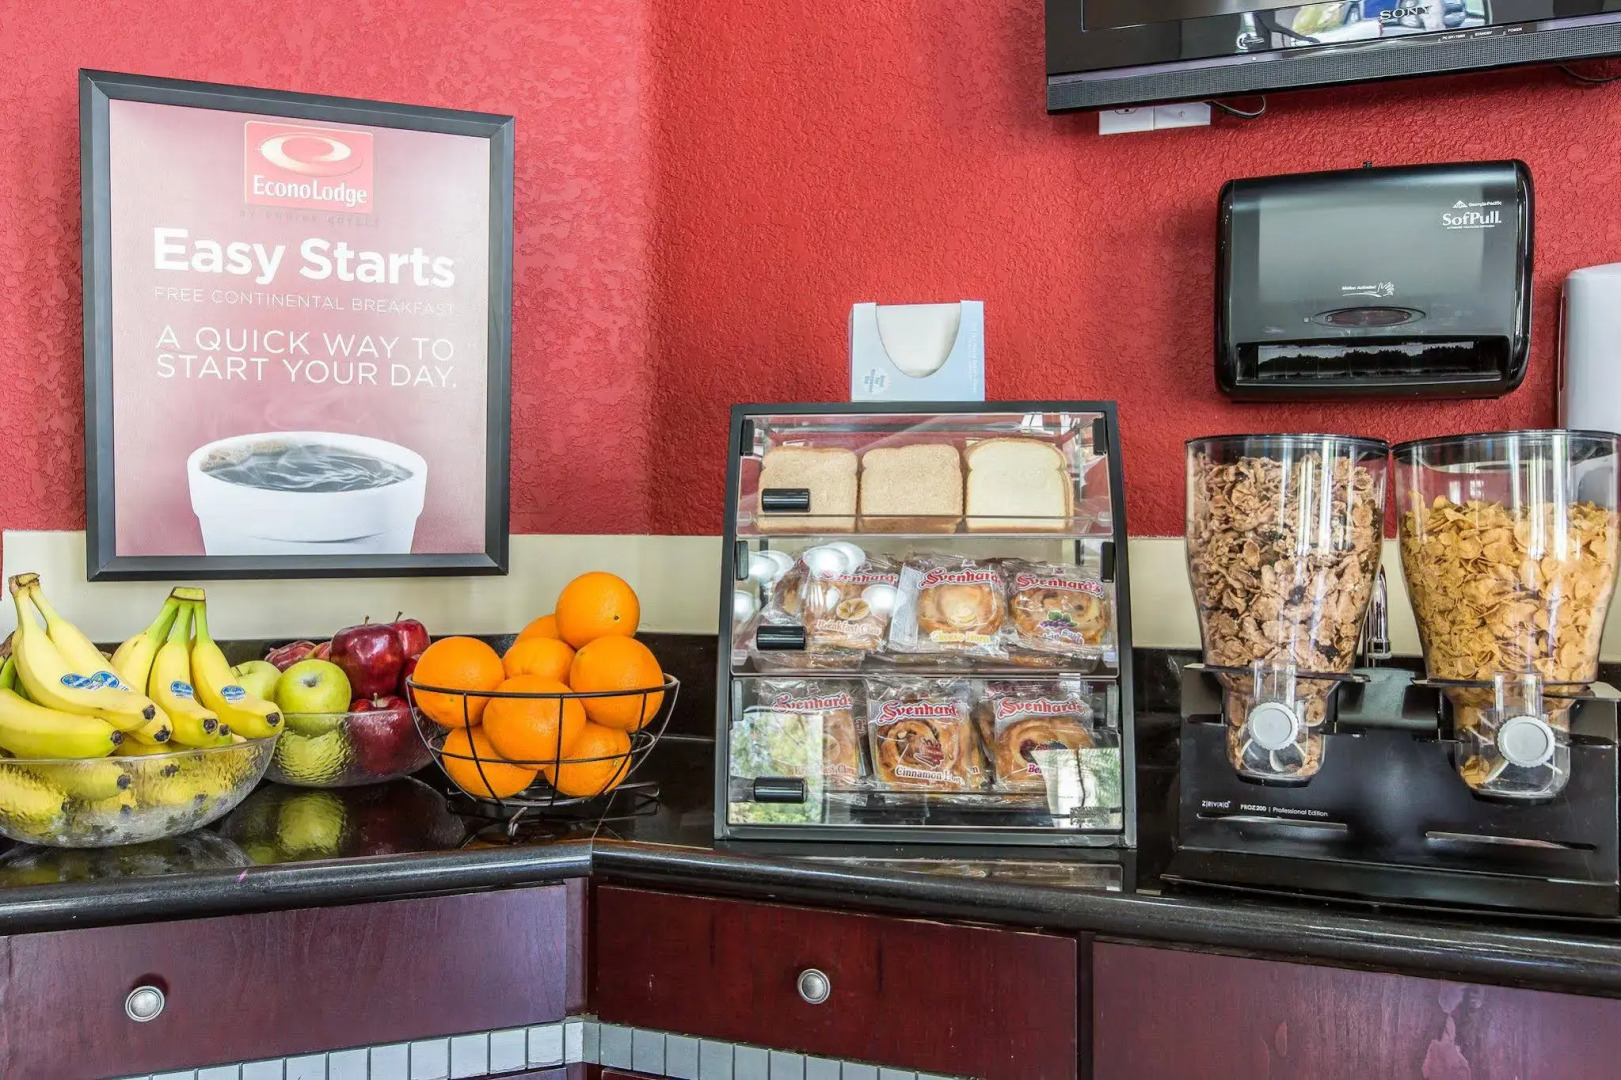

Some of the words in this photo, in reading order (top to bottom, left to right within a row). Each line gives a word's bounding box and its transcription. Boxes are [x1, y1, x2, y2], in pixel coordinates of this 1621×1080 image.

[1379, 5, 1432, 20] SONY
[253, 174, 368, 207] EconoLodge
[154, 227, 286, 285] Easy
[299, 238, 456, 288] Starts
[154, 287, 204, 301] FREE
[211, 288, 345, 310] CONTINENTAL
[156, 325, 180, 349] A
[195, 327, 310, 355] QUICK
[323, 333, 399, 358] WAY
[411, 338, 454, 361] TO
[157, 354, 269, 381] START
[282, 359, 378, 385] YOUR
[391, 364, 457, 388] DAY.
[1016, 574, 1101, 593] Svenhard's
[998, 700, 1085, 719] Svenhard's
[895, 765, 943, 781] Cinnamon
[1240, 804, 1267, 812] PROZ200
[1273, 807, 1307, 816] Professional
